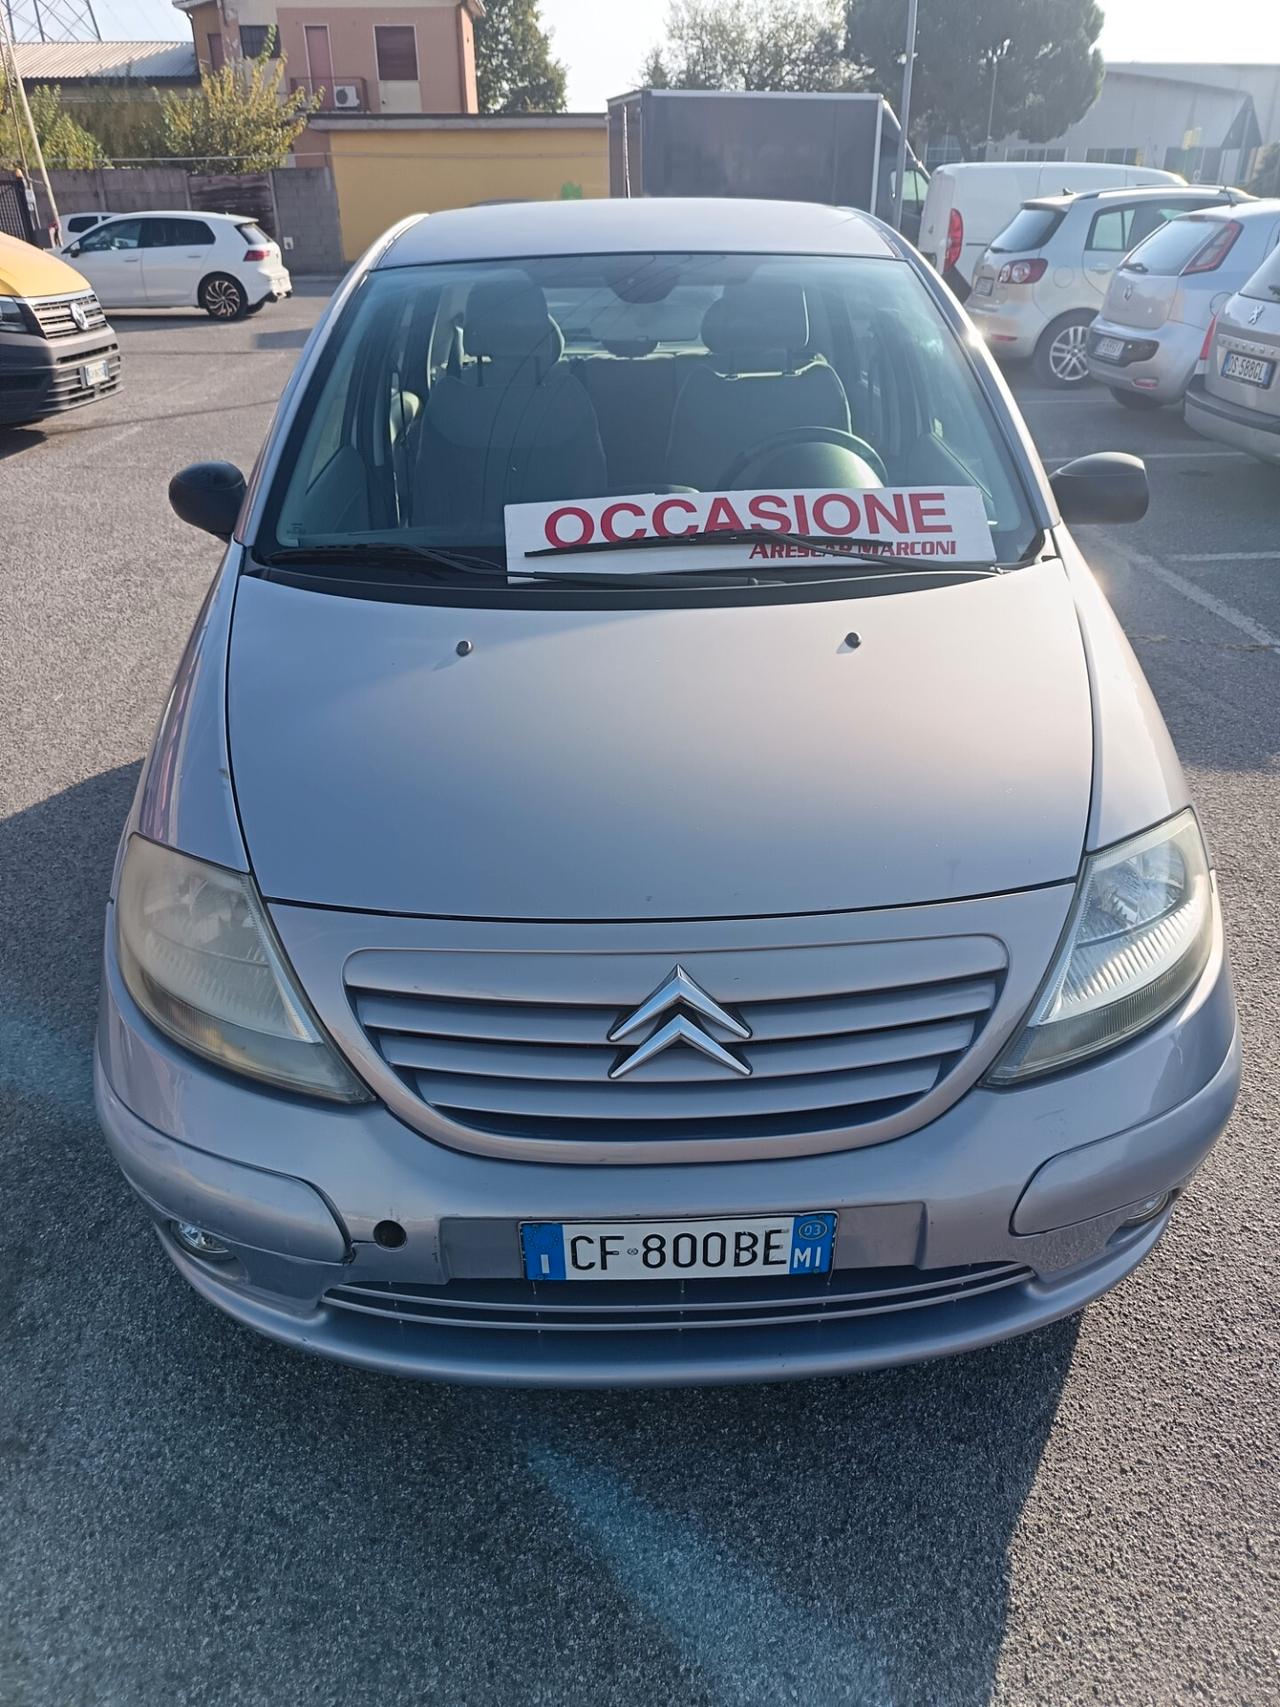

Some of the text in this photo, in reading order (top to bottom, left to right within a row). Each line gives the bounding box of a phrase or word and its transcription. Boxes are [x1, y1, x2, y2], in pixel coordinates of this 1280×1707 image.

[544, 492, 953, 549] OCCASIONE
[858, 540, 957, 556] MARCONI
[804, 1224, 822, 1236] 03
[570, 1228, 790, 1271] CF 800BE
[793, 1246, 822, 1269] MI
